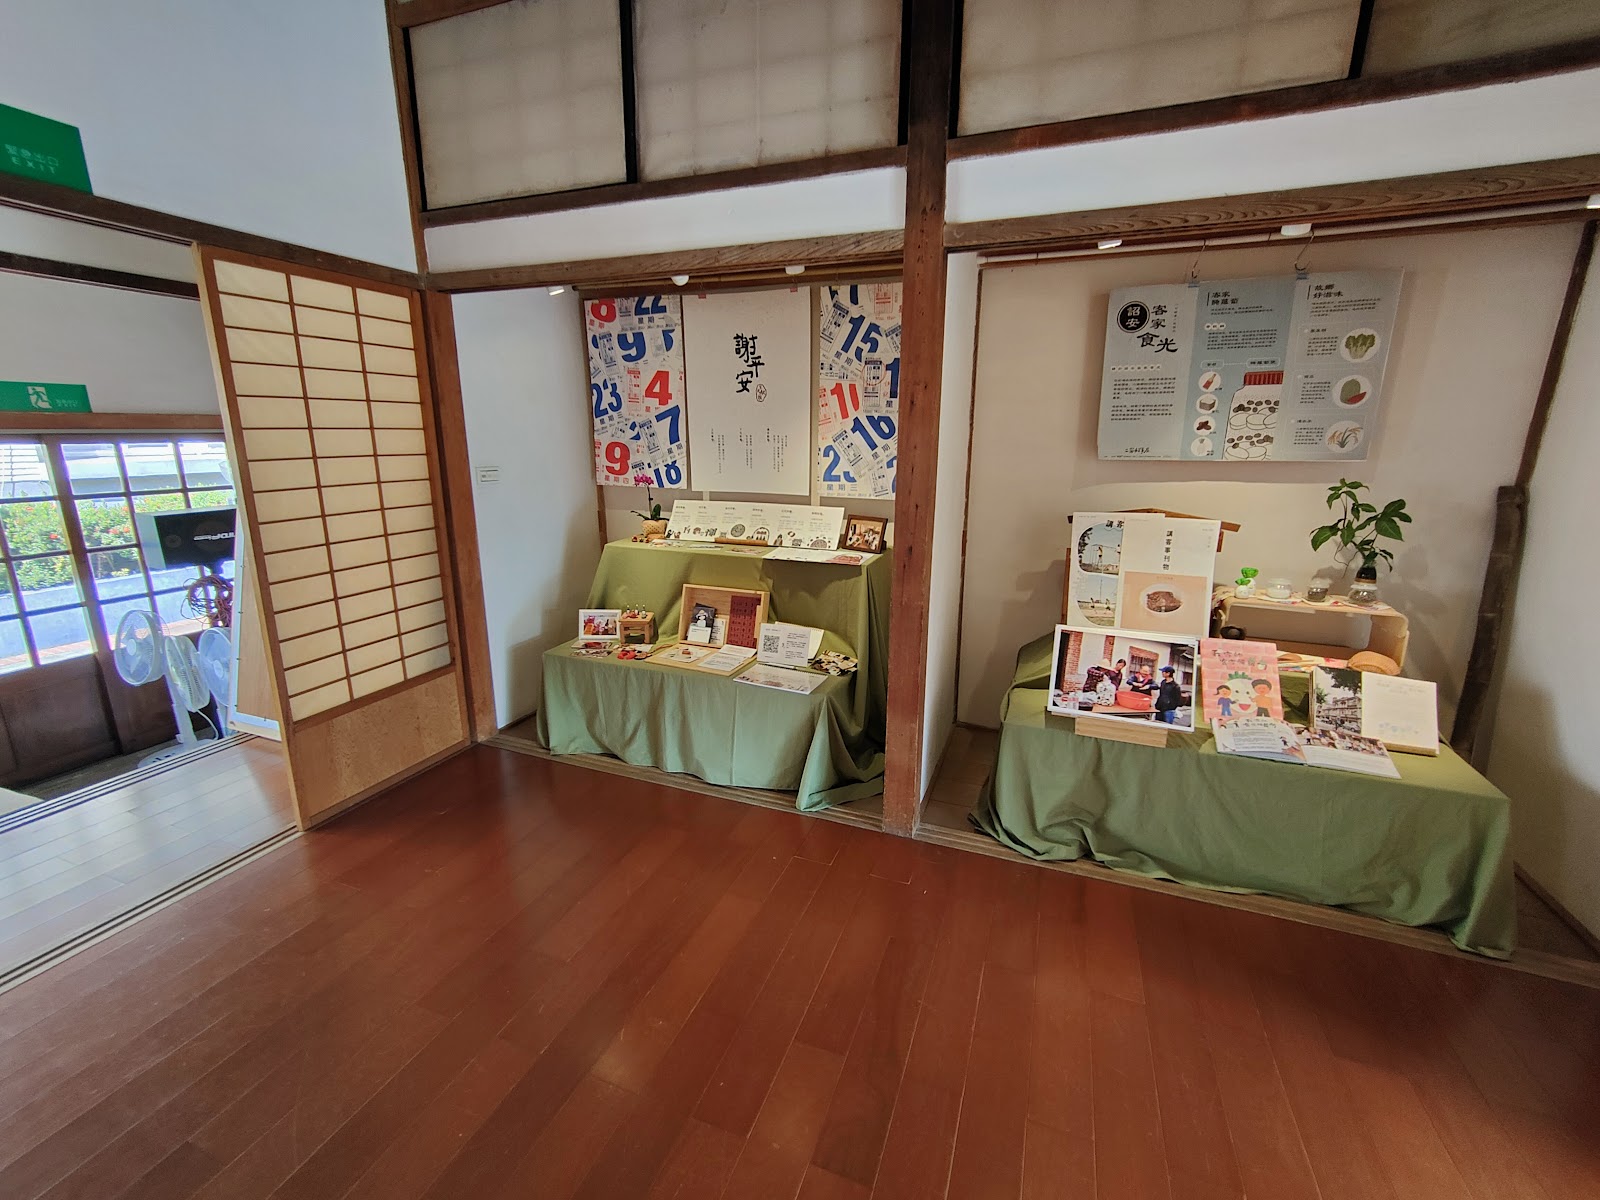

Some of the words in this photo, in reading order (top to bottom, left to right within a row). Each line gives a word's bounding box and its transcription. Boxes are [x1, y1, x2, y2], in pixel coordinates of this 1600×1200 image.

[841, 314, 882, 363] 15
[733, 333, 765, 393] 謝平安
[591, 379, 622, 418] 23
[645, 370, 672, 406] 4
[655, 405, 680, 445] 7
[850, 415, 896, 452] 16
[605, 441, 630, 476] 9
